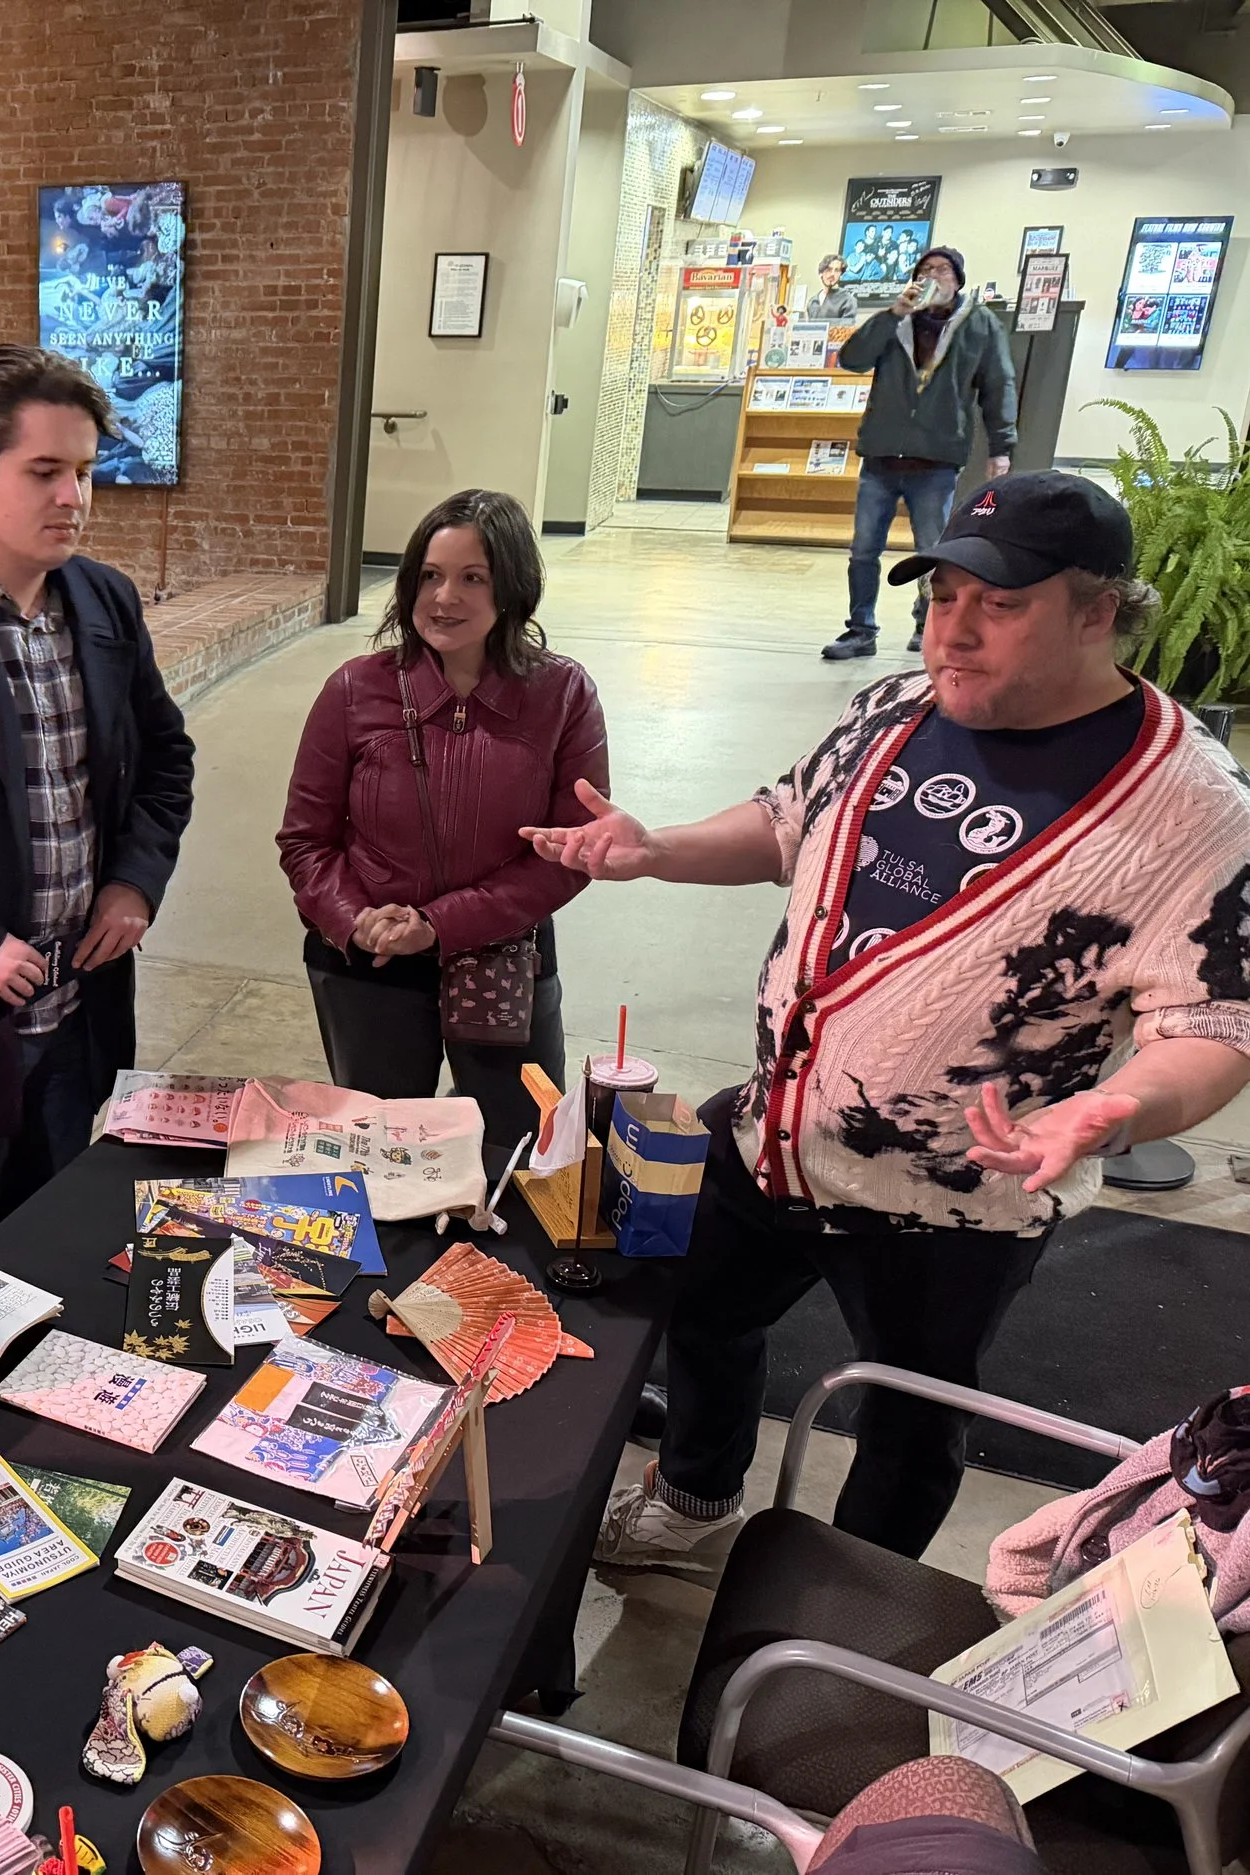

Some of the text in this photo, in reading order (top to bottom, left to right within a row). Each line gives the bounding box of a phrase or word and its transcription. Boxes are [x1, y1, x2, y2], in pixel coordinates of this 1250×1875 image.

[691, 271, 734, 283] Bavarian
[58, 300, 162, 321] NEVER
[50, 332, 174, 346] SEEN ANYTHING
[81, 357, 161, 378] IKE...
[882, 850, 925, 875] TULSA
[876, 860, 930, 889] GLOBAL
[870, 869, 942, 904] ALLIANCE
[32, 1539, 64, 1558] AREA
[1, 1545, 72, 1581] UTSUNOMIYA
[40, 1555, 79, 1576] COOL JAPAN
[302, 1548, 366, 1620] JAPAN
[960, 1671, 986, 1690] EMS
[12, 1784, 22, 1805] CITIES
